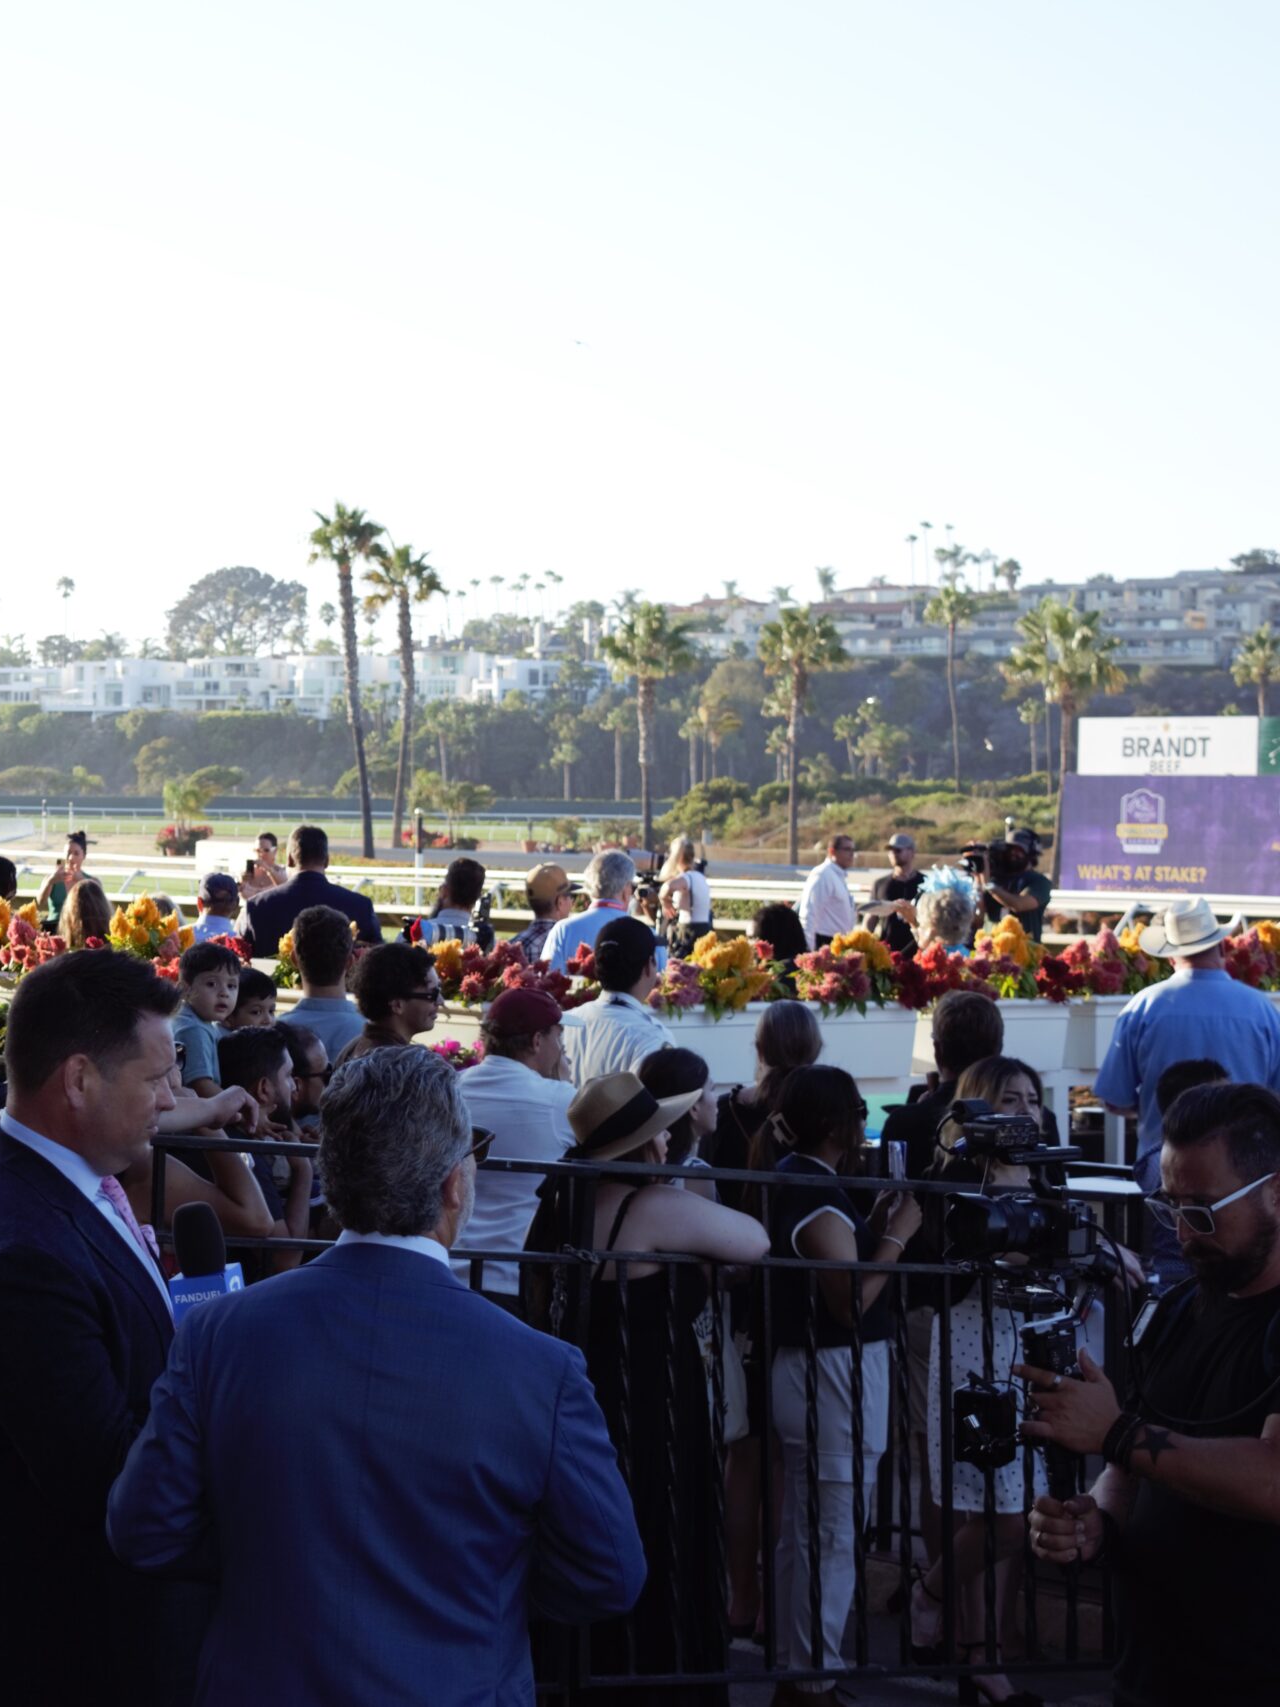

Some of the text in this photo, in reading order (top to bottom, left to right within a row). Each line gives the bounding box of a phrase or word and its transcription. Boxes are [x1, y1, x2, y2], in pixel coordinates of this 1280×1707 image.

[1122, 736, 1211, 758] BRANDT
[1150, 760, 1181, 773] BEEF
[1077, 864, 1207, 883] WHAT'S AT STAKE?
